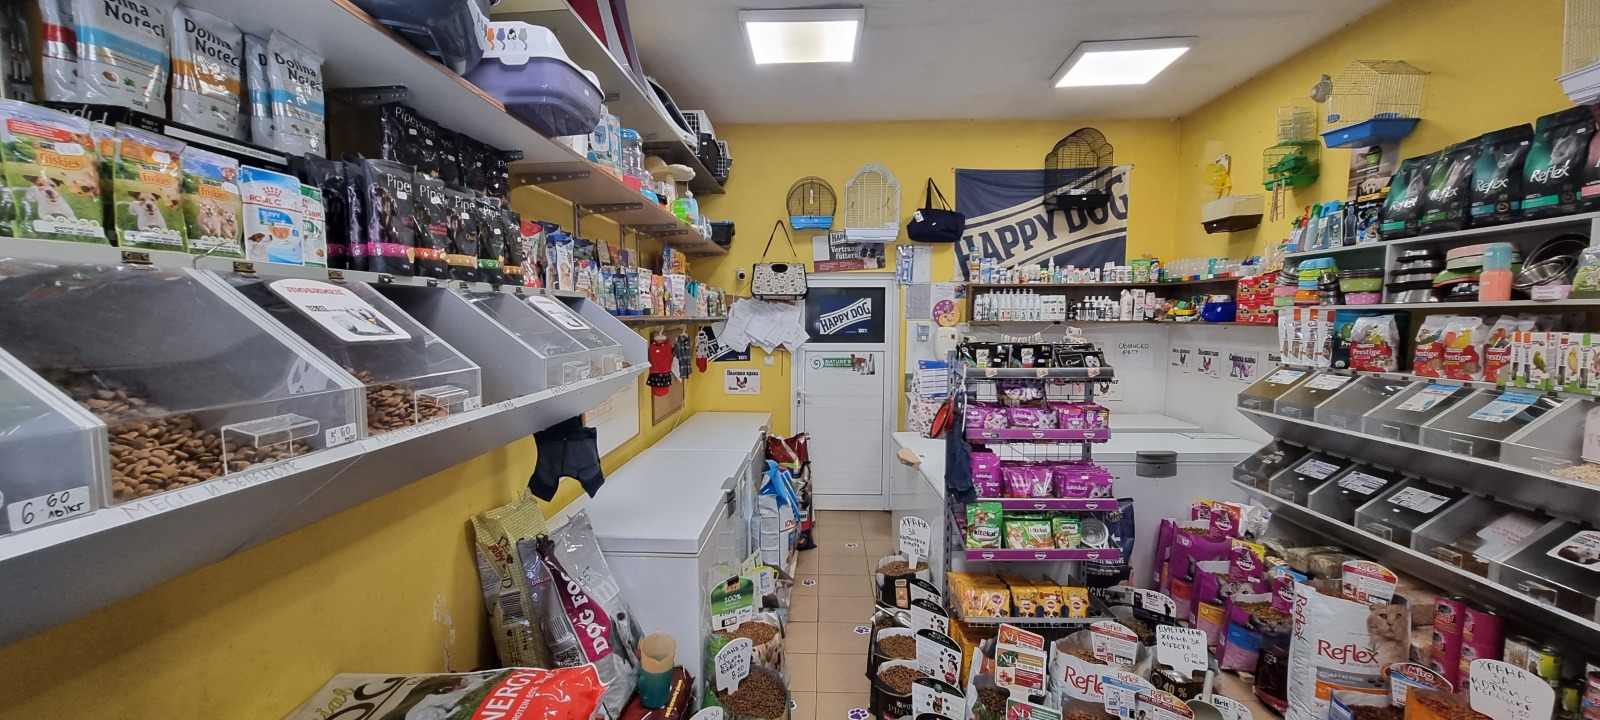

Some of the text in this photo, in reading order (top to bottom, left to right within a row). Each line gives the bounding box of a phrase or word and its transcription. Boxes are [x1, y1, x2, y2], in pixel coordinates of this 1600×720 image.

[184, 17, 233, 50] Dolina
[274, 51, 316, 77] Dolina
[395, 106, 417, 127] Pipe
[39, 153, 80, 168] Friskies
[1530, 163, 1570, 184] Reflex
[1475, 177, 1508, 194] Reflex
[455, 195, 476, 211] Pipe
[955, 211, 1057, 281] HAPPY
[820, 302, 871, 334] HAPPY DOG
[1353, 349, 1381, 357] Prestige
[724, 594, 742, 603] 100%
[1294, 594, 1308, 641] Reflex
[1317, 639, 1379, 665] Reflex
[1064, 665, 1104, 695] Refle
[1117, 672, 1139, 684] Reflex
[1478, 660, 1527, 681] ХРАНА
[1492, 675, 1509, 686] ЗА
[480, 671, 537, 720] NERGY
[1150, 690, 1174, 704] Reflex
[1164, 682, 1187, 698] 40 %
[512, 698, 531, 720] ROTEIN
[1214, 698, 1229, 707] Brit
